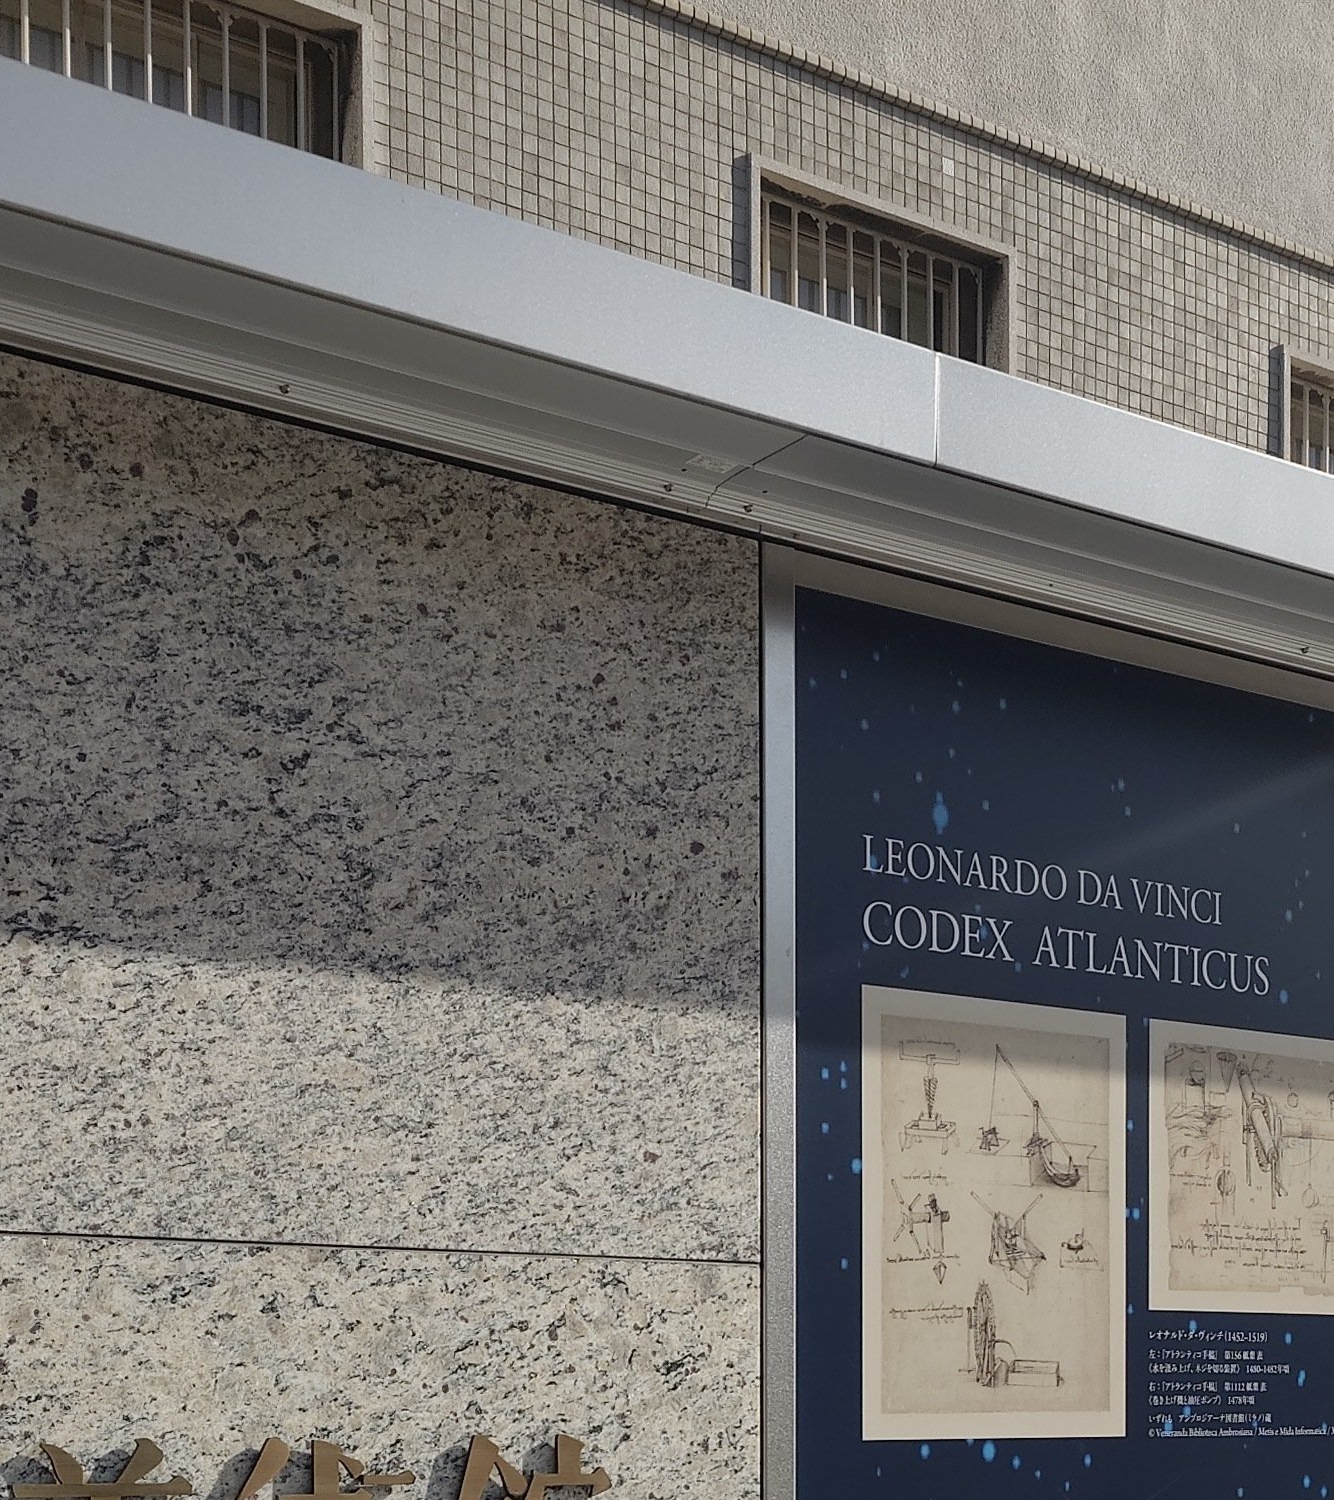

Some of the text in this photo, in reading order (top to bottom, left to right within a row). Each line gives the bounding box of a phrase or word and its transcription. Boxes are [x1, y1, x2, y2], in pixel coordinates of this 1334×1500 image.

[862, 834, 1224, 926] LEONARDO DA VINCI
[862, 901, 1271, 996] CODEX ATLANTICUS
